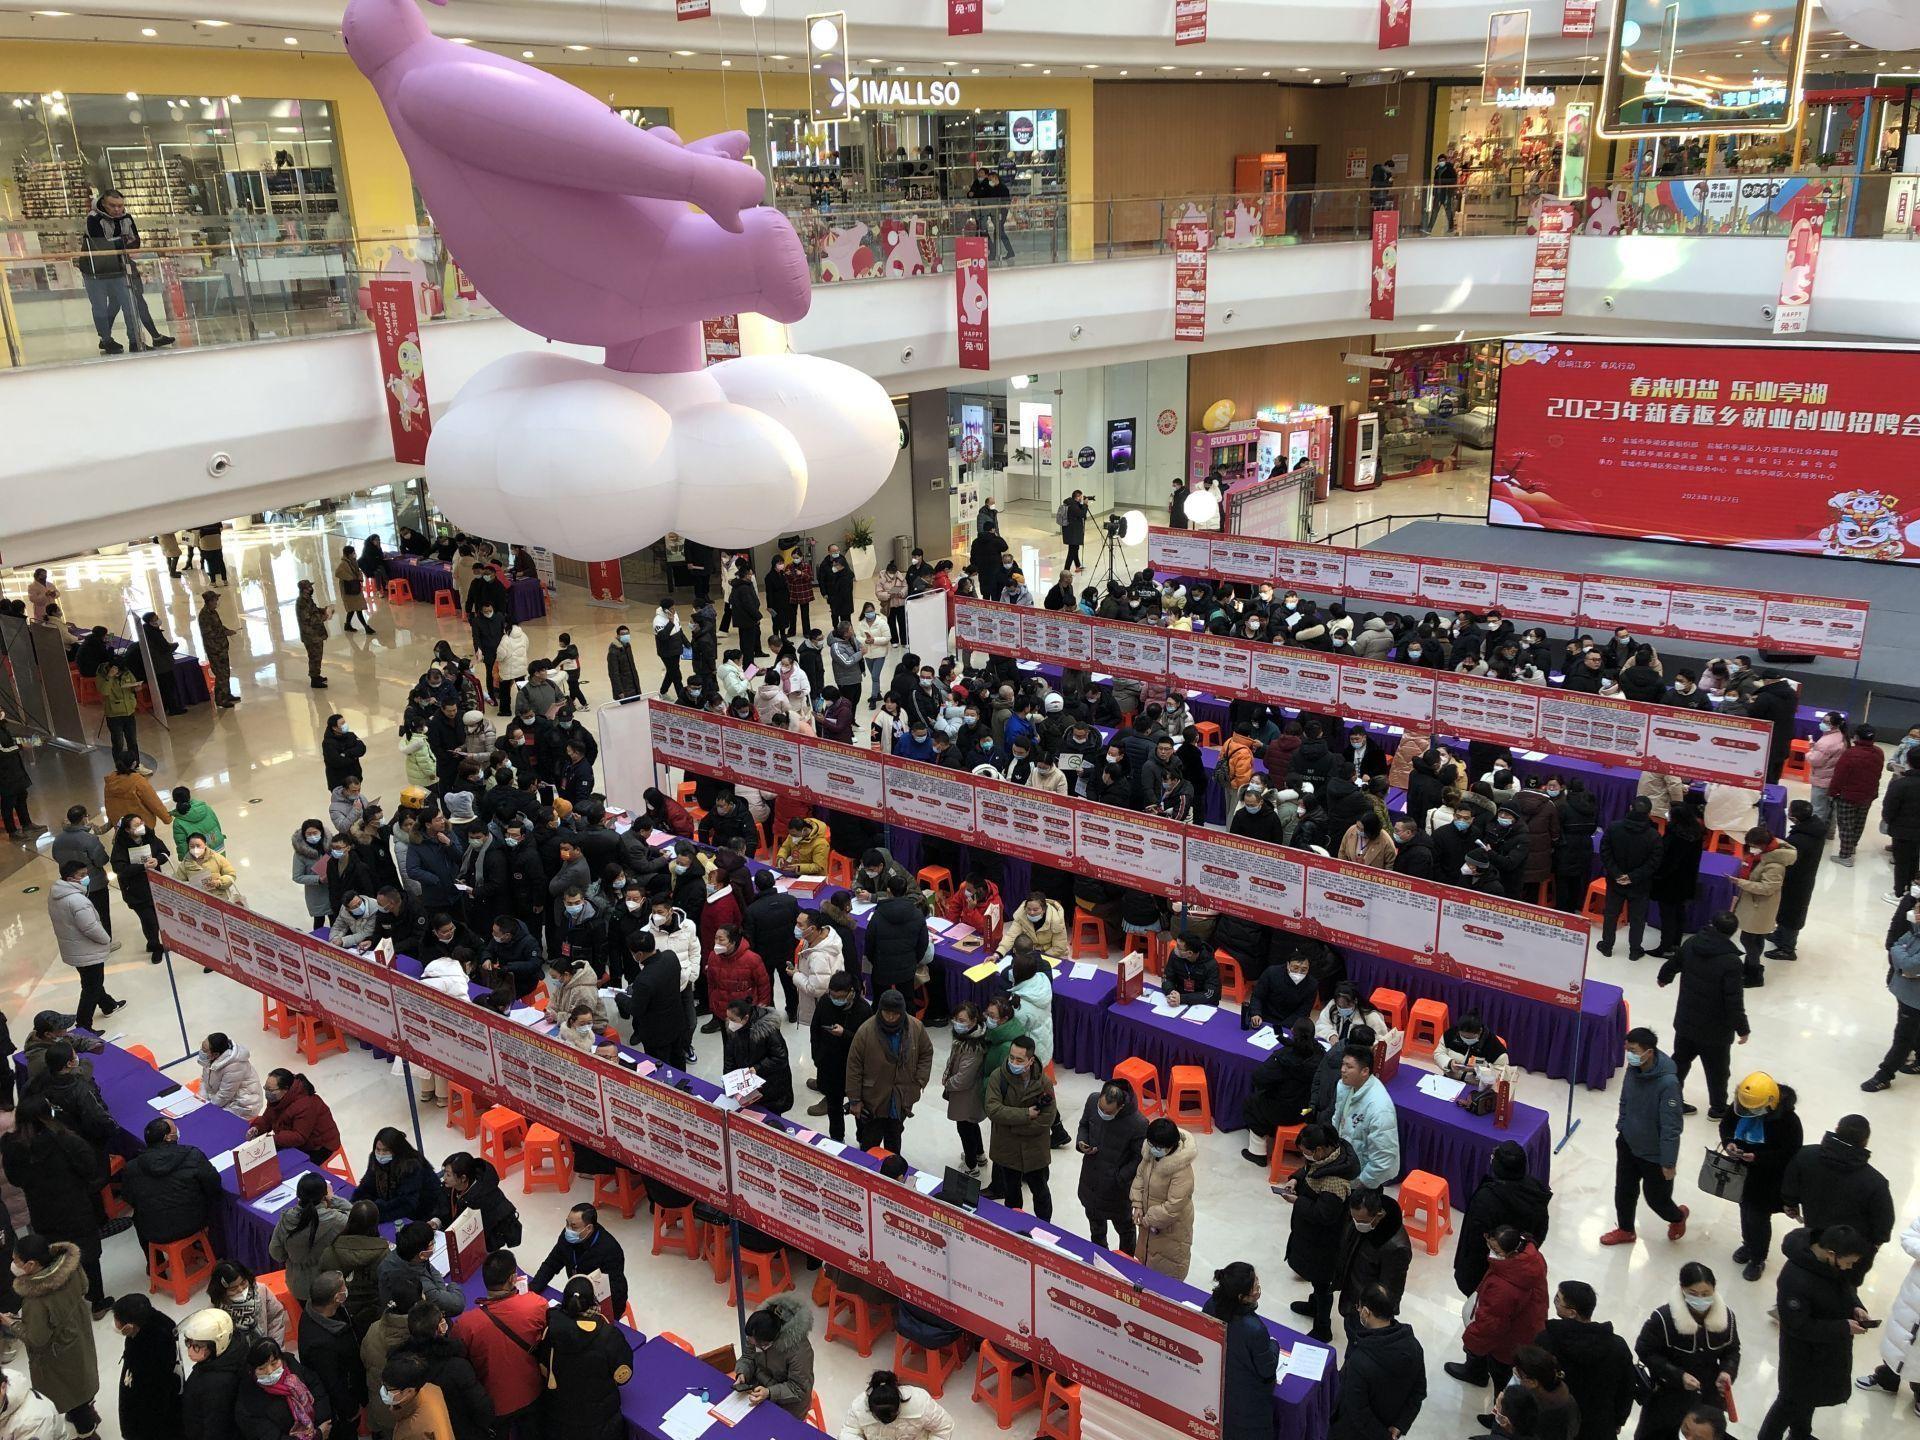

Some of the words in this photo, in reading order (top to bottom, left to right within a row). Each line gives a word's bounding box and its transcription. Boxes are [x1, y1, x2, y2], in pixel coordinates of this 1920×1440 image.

[862, 80, 961, 106] IMALLSO
[963, 330, 983, 338] HAPPY
[1600, 361, 1636, 371] 春风行动
[1629, 376, 1720, 400] 春来归盐
[1730, 380, 1829, 405] 乐业亭湖
[1547, 398, 1920, 437] 2023年新春返乡就业创业招聘会
[1210, 434, 1237, 446] SUPER
[1681, 493, 1739, 503] 2023年1月27日
[1439, 964, 1450, 972] 51
[737, 1209, 747, 1218] 61
[898, 1219, 919, 1235] 服务员
[919, 1228, 932, 1240] 3人
[877, 1276, 889, 1288] 62
[1112, 1289, 1141, 1308] 丰收宴
[1085, 1306, 1098, 1318] 2人
[1143, 1333, 1167, 1348] 服务员
[1168, 1343, 1181, 1355] 6人
[1039, 1352, 1054, 1366] 63
